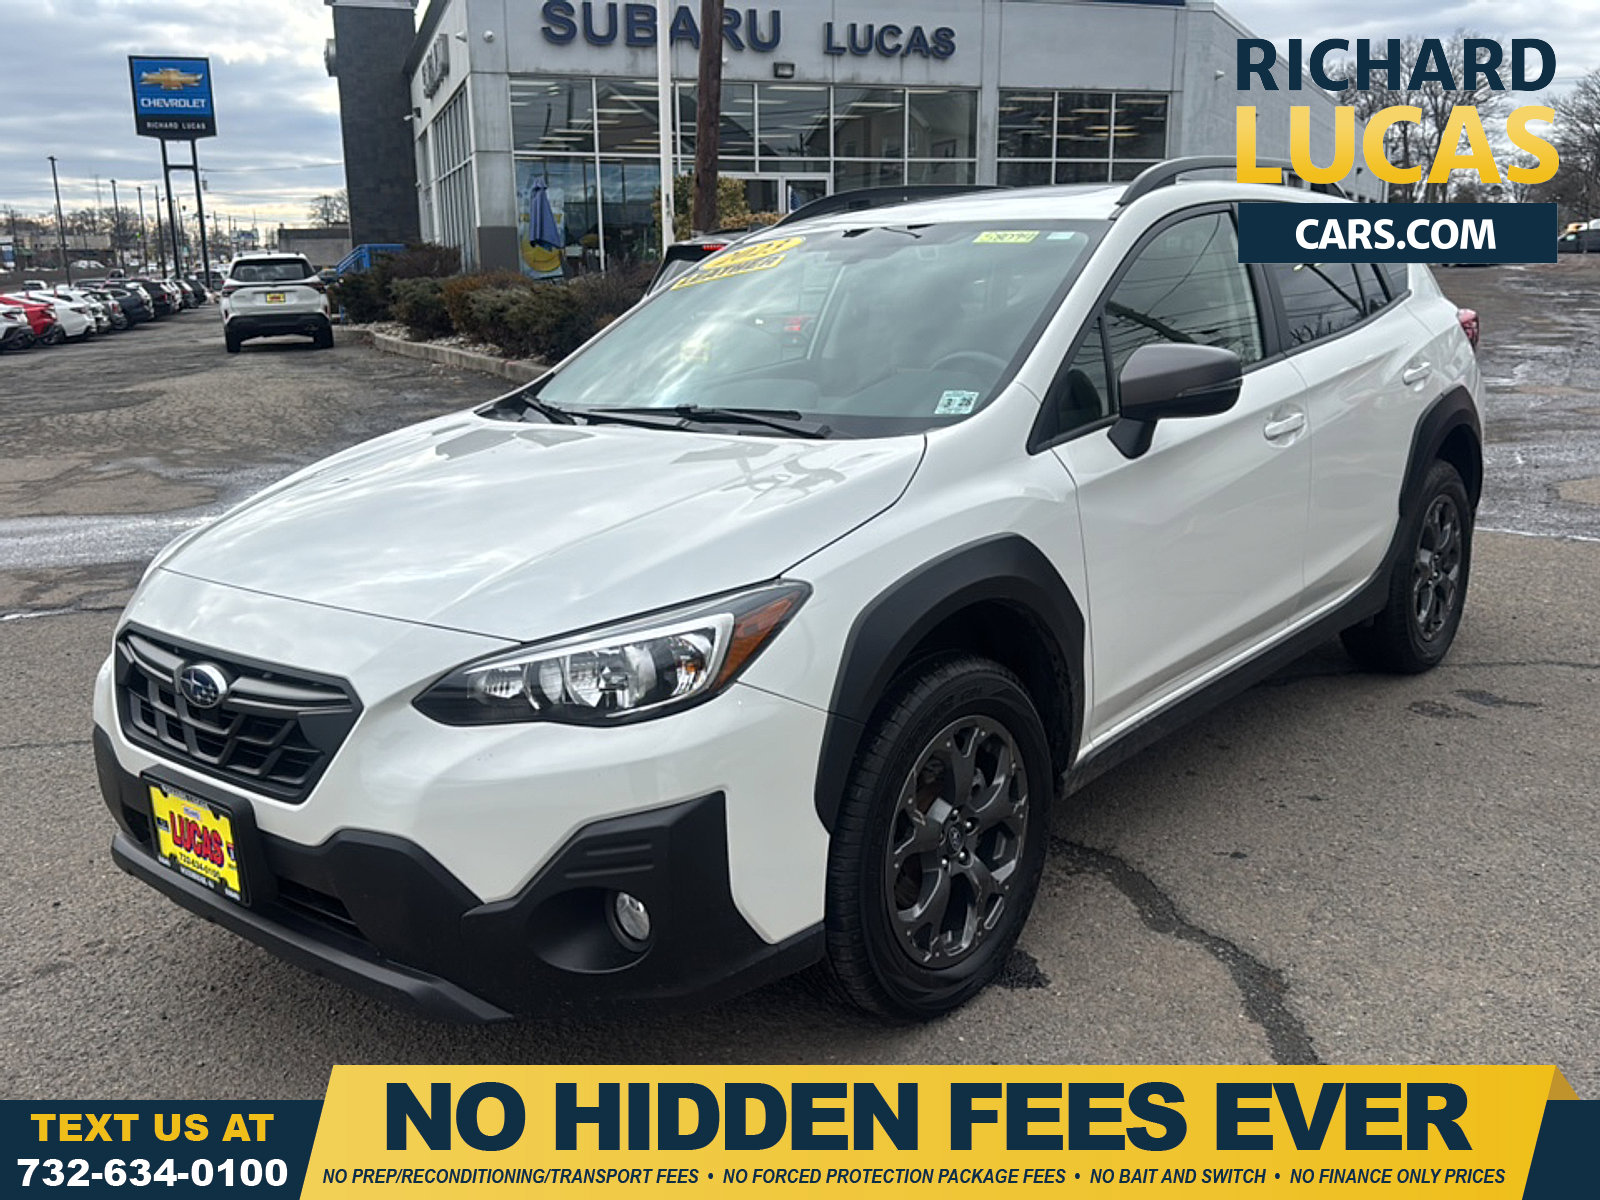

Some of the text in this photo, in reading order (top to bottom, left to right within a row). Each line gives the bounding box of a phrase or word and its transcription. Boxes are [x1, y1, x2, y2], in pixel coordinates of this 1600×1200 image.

[541, 0, 781, 52] SUBARU
[823, 21, 957, 60] LUCAS
[140, 97, 207, 108] CHEVROLET
[146, 121, 207, 131] RICHARD LUCAS
[168, 810, 224, 868] LUCAS
